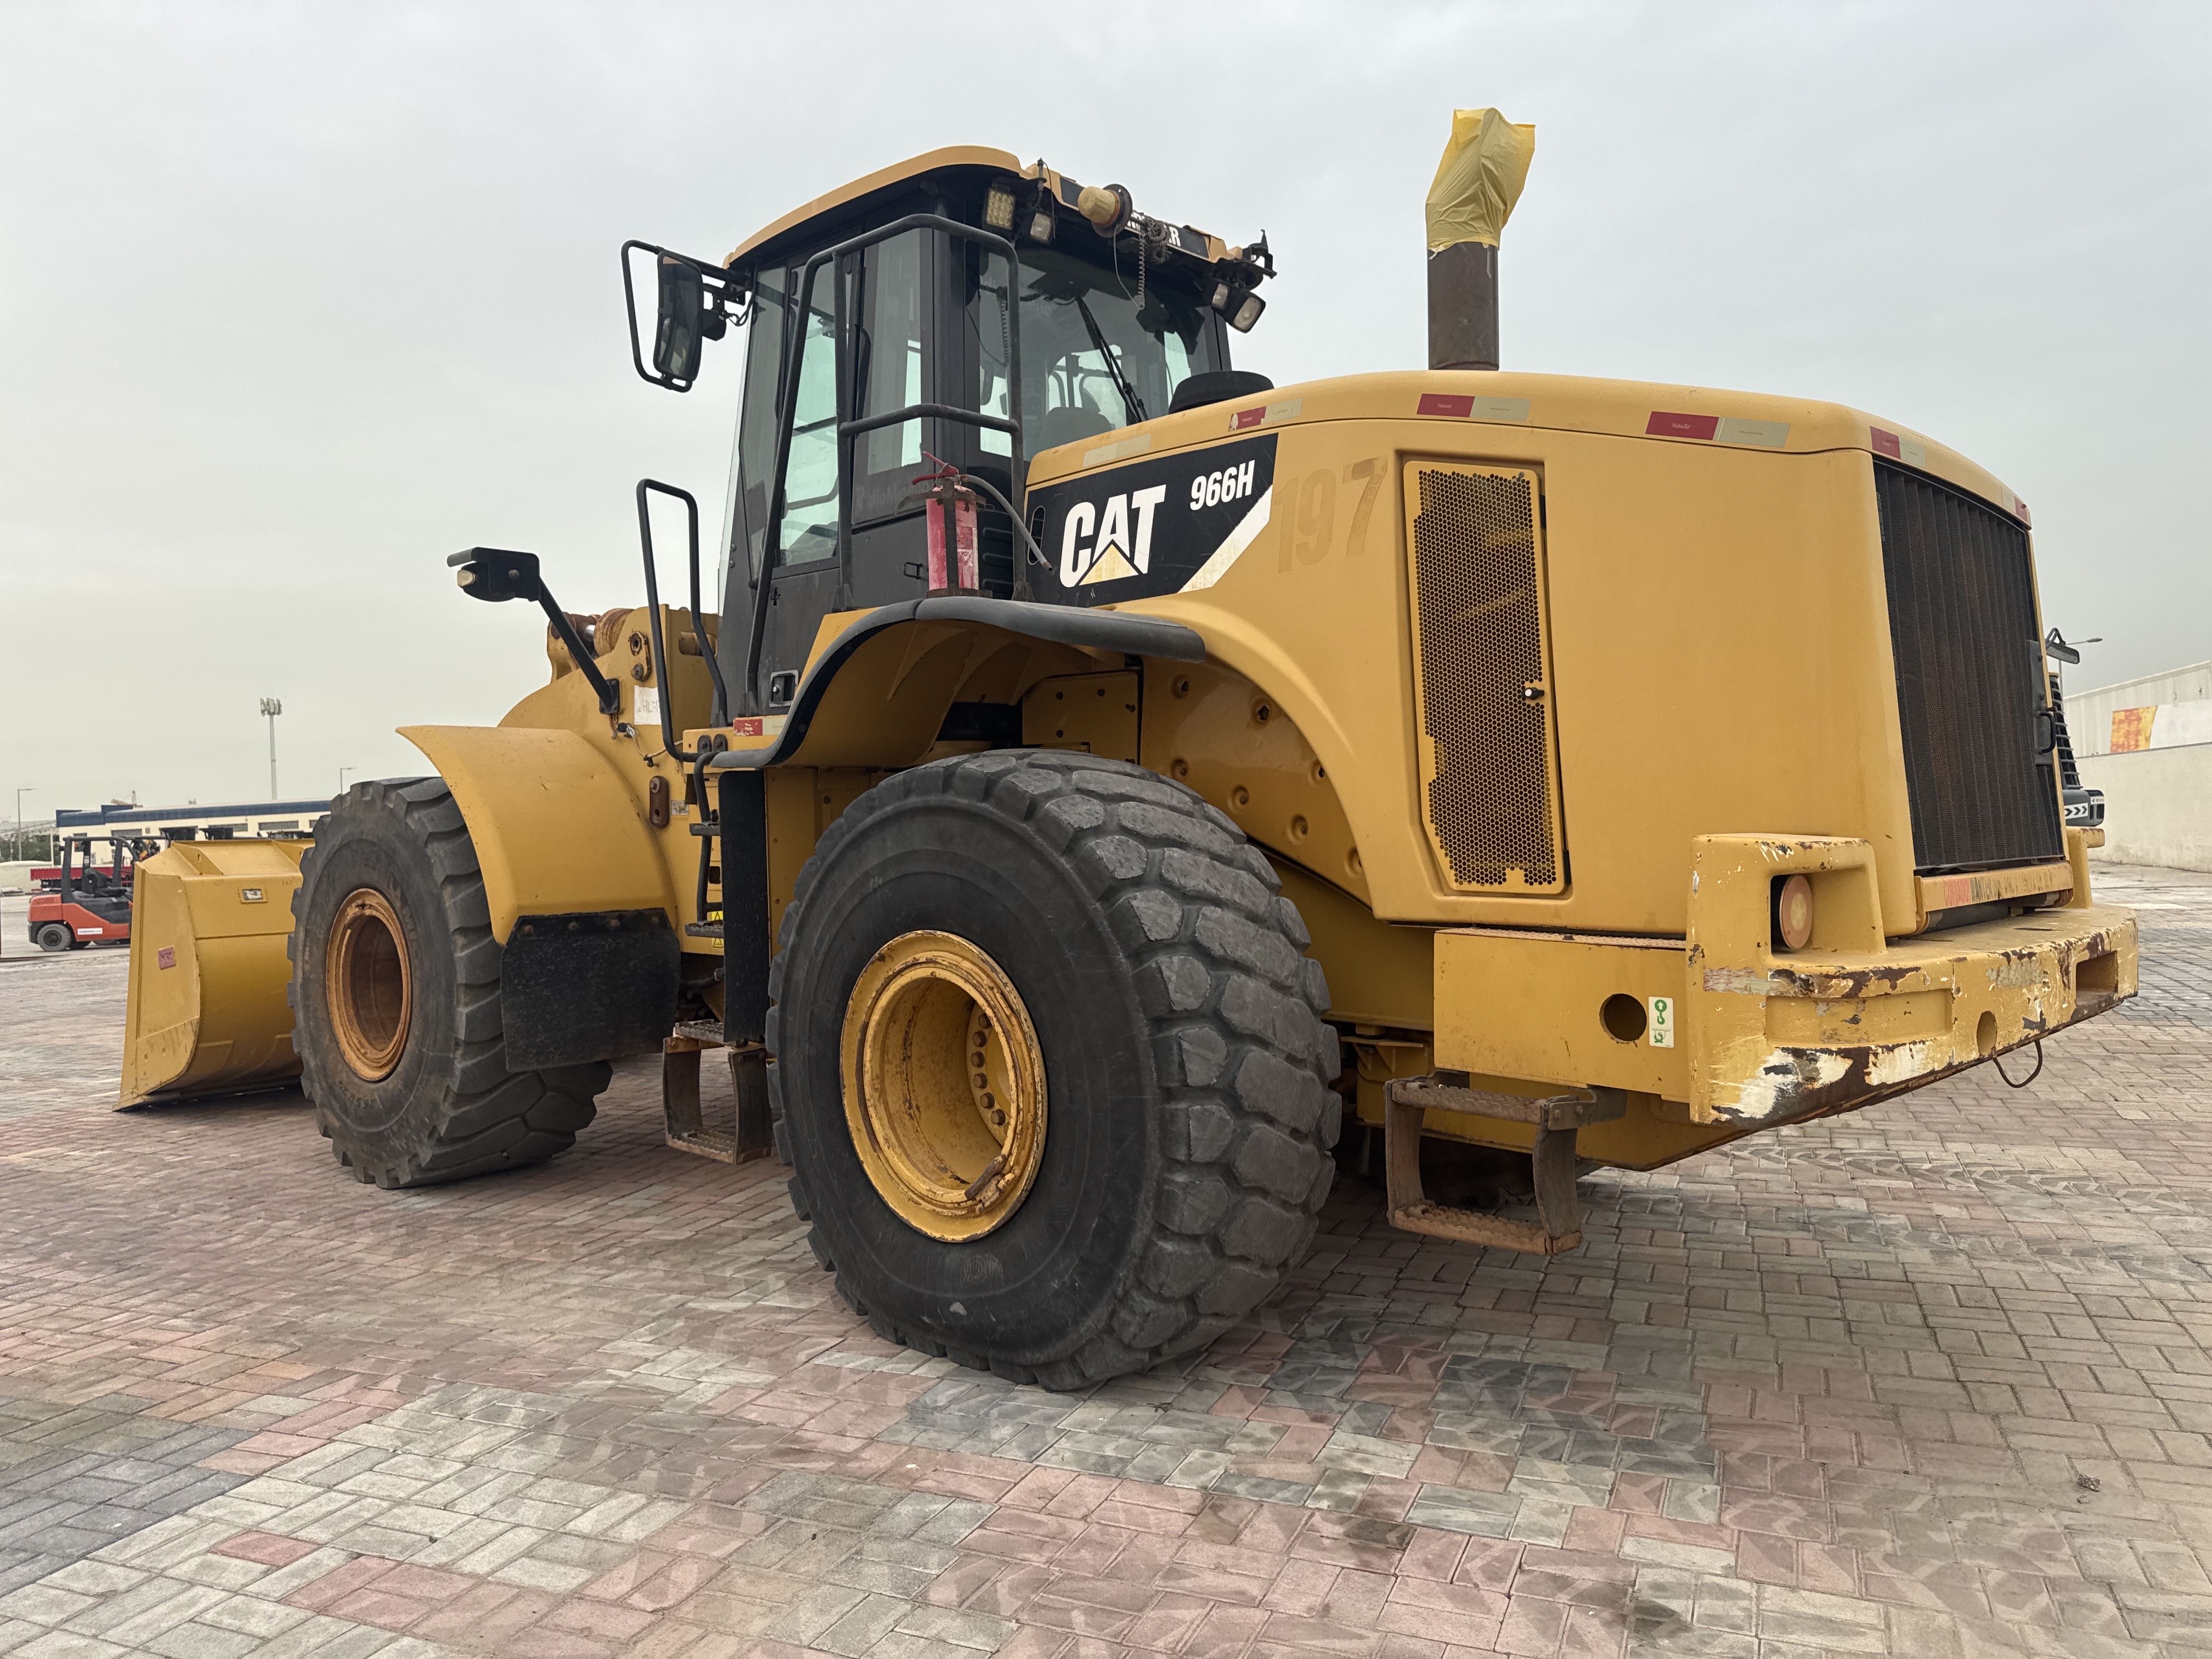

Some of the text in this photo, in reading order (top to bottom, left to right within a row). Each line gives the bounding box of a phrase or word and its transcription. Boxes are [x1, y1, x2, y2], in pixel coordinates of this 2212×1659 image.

[1059, 484, 1166, 588] CAT
[1189, 460, 1256, 511] 966H
[1274, 455, 1389, 574] 197
